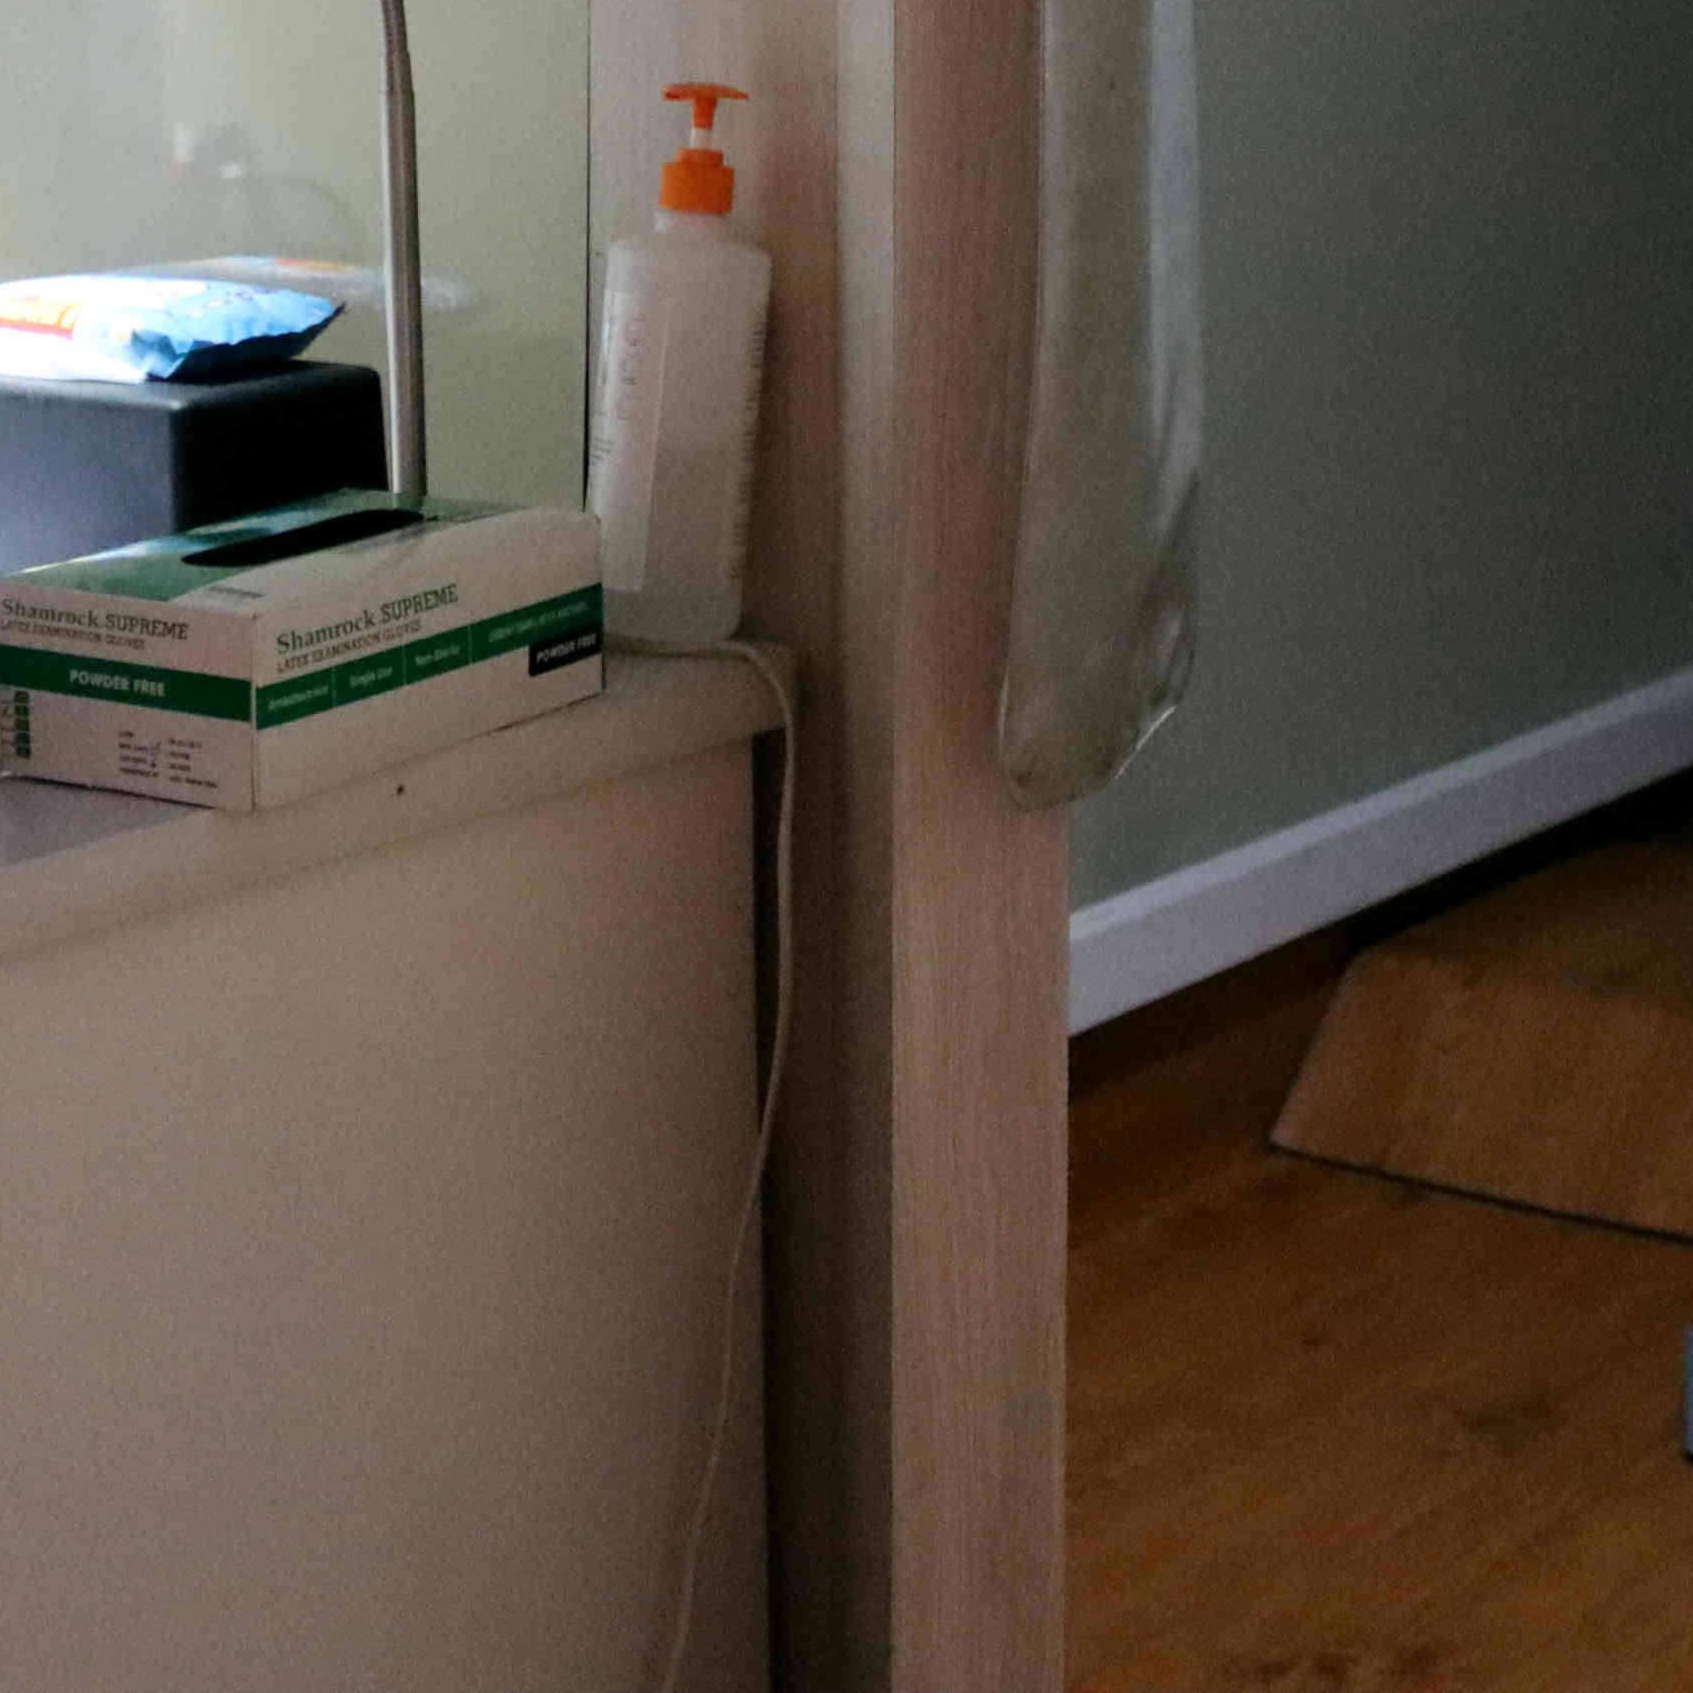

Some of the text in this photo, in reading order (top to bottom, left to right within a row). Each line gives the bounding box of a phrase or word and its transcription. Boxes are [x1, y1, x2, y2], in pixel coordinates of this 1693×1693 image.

[1, 598, 188, 640] Shamrock SUPREME
[277, 609, 376, 655] Shamrock
[380, 583, 458, 623] SUPREME
[277, 619, 421, 674] LATEX EXAMINATION GLOVES
[535, 633, 597, 664] POWDER FREE
[69, 669, 167, 698] POWDER FREE
